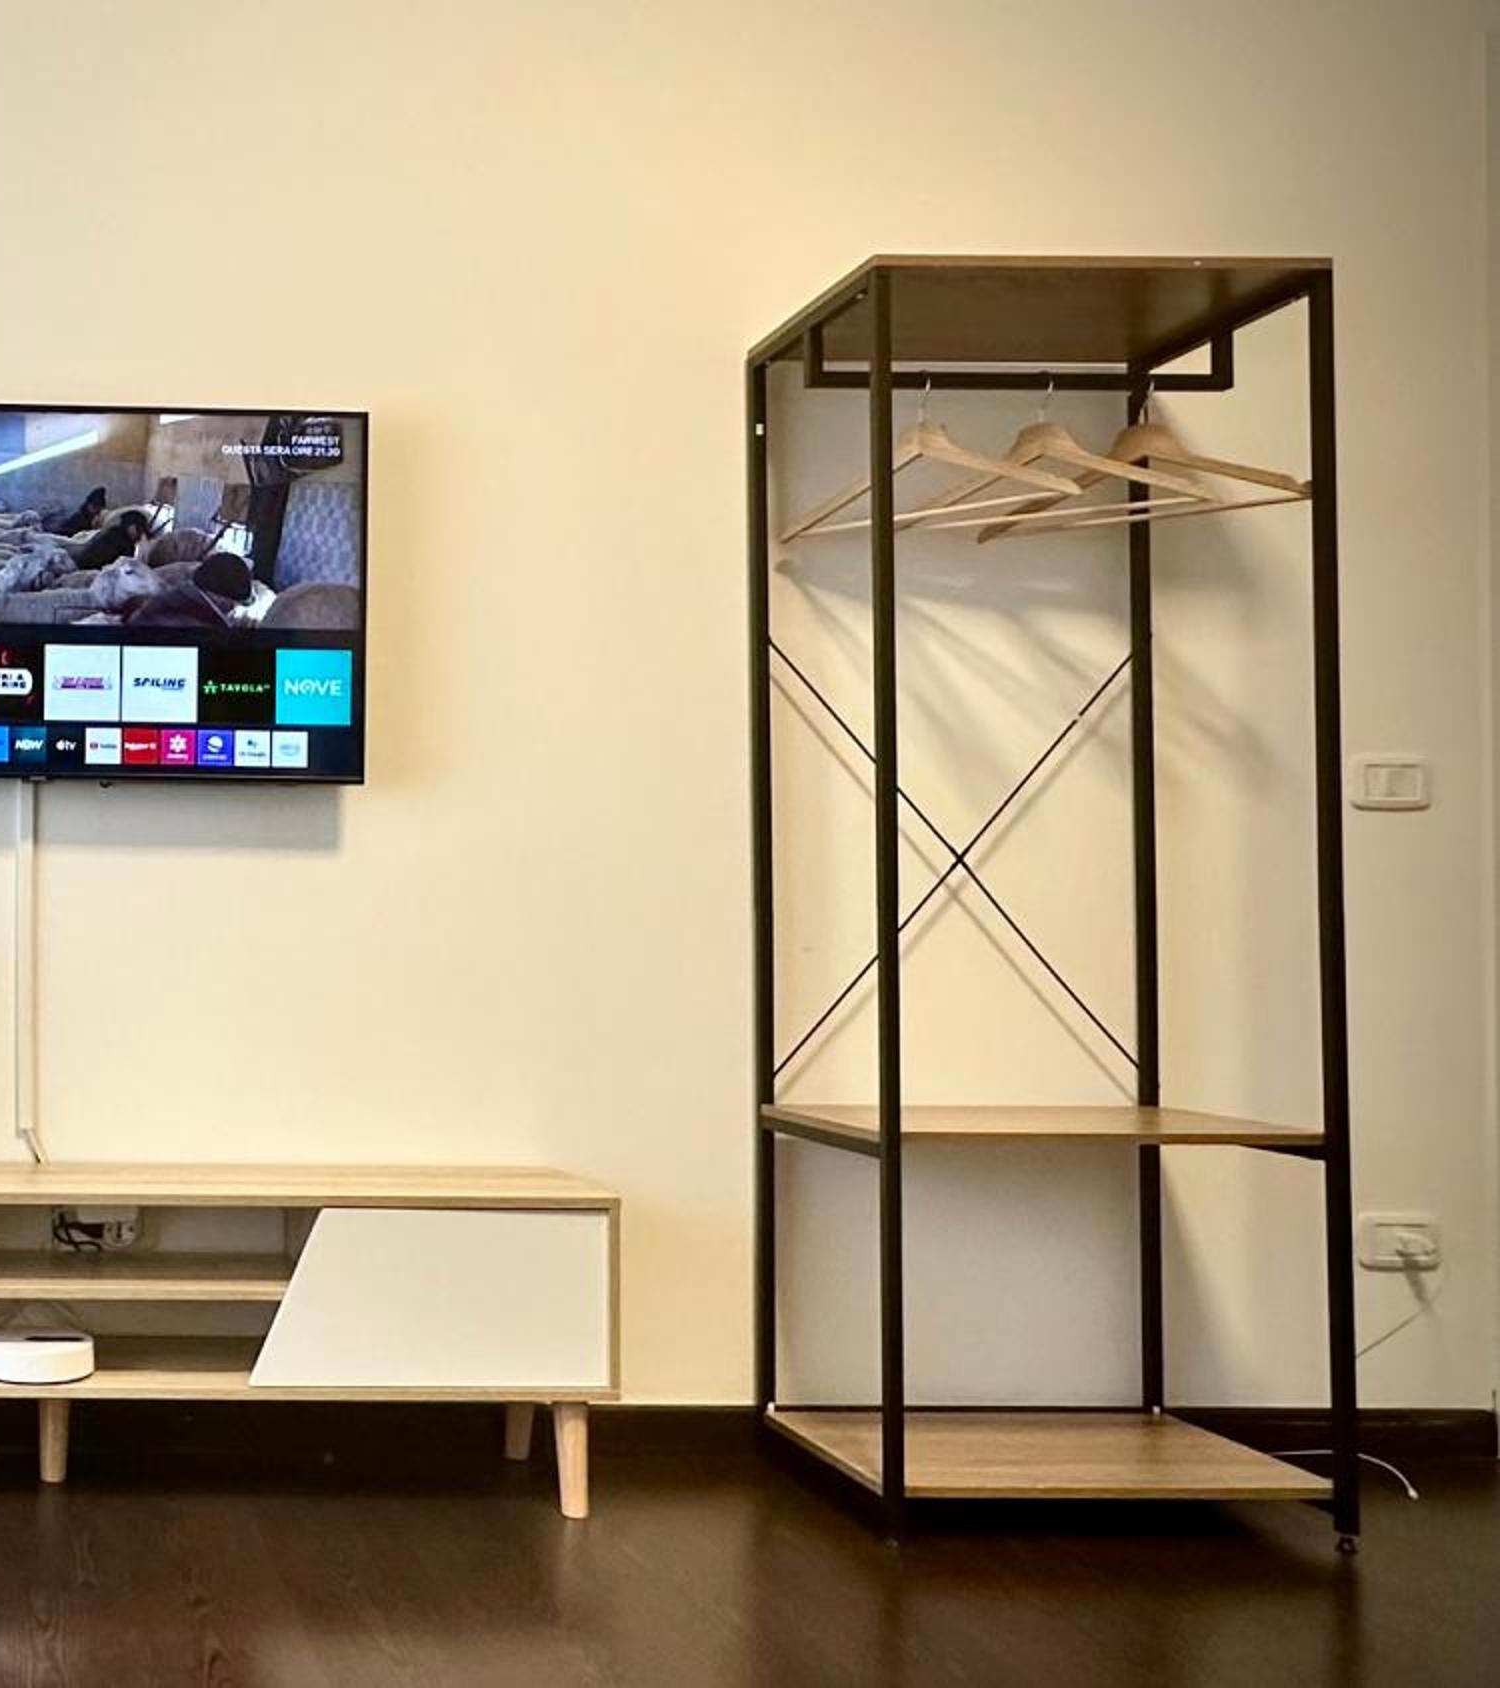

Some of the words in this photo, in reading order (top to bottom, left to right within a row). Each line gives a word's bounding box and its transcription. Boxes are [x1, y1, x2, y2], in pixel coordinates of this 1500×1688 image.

[221, 445, 262, 456] QUESTA
[263, 445, 290, 456] SERA
[284, 679, 342, 697] NOVE
